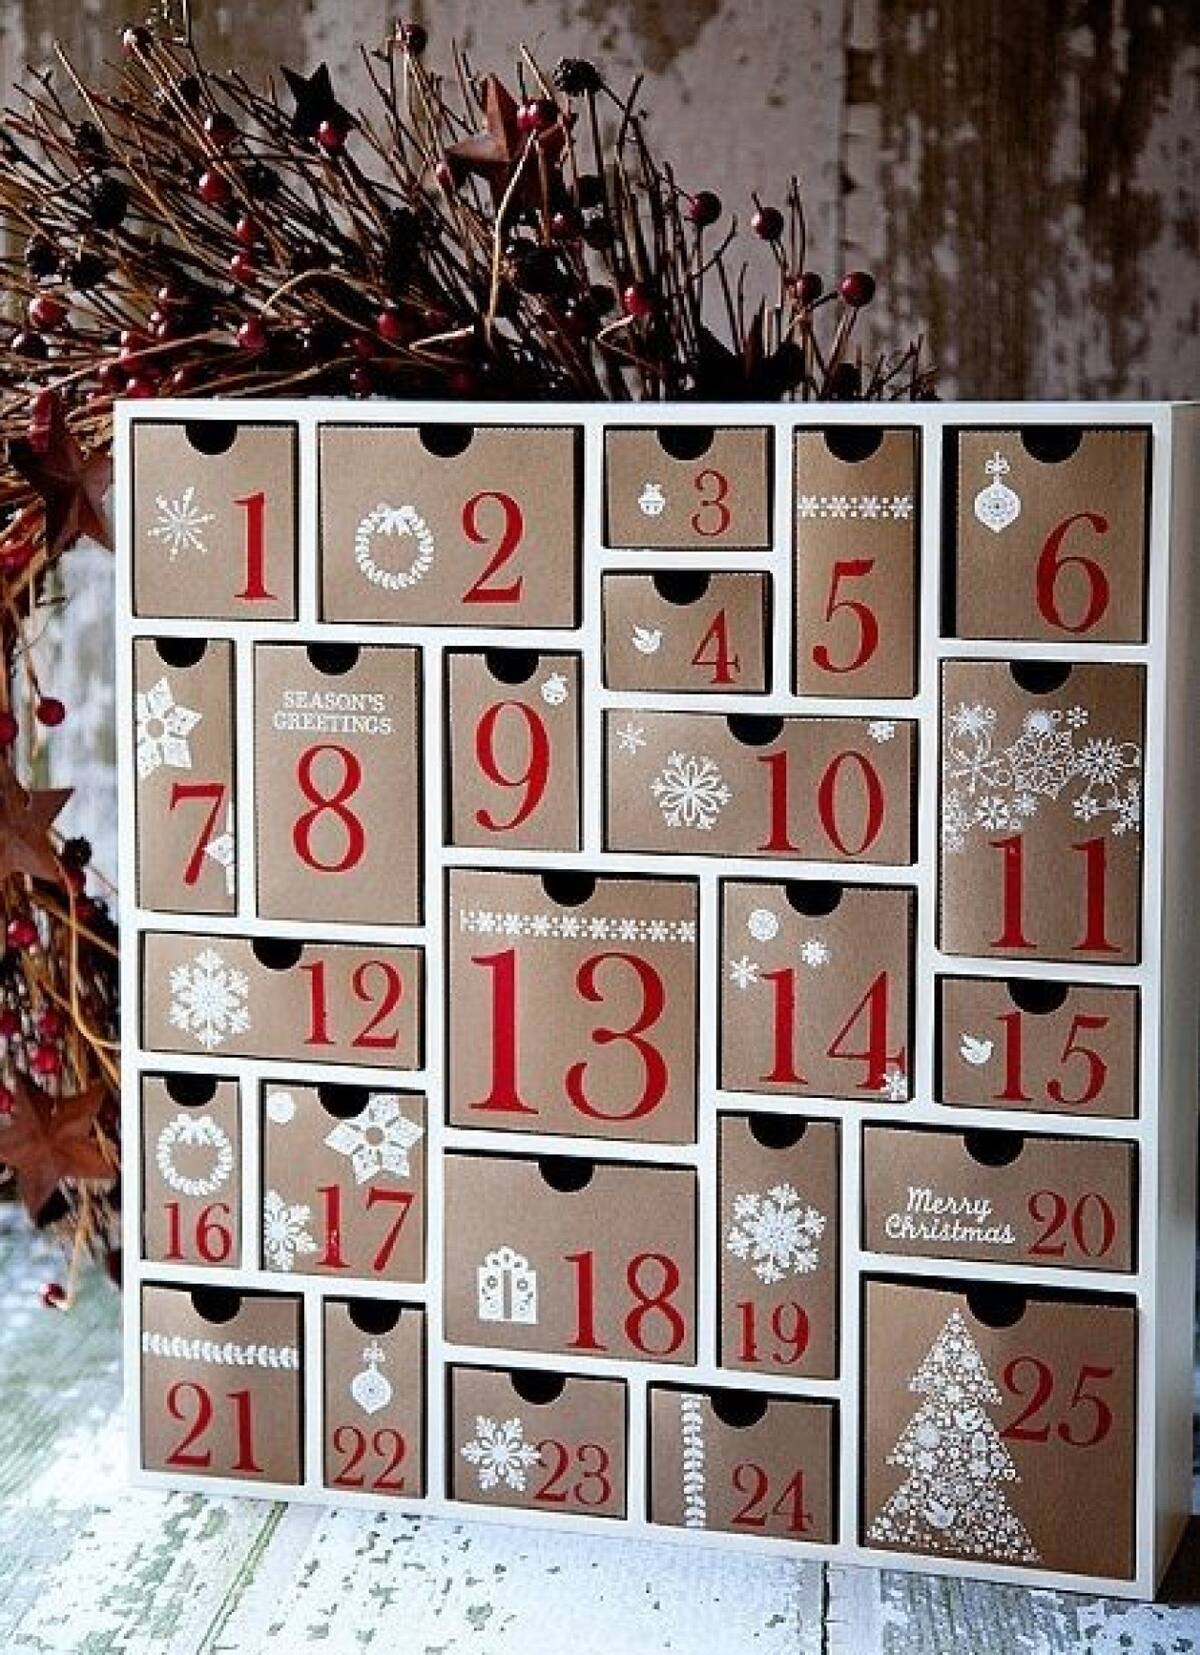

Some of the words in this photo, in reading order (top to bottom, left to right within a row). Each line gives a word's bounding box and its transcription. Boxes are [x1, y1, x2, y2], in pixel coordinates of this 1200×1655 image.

[234, 491, 277, 602] 1
[462, 491, 525, 604] 2
[691, 470, 732, 536] 3
[812, 558, 879, 673] 5
[1035, 512, 1111, 634] 6
[691, 608, 741, 684] 4
[273, 710, 392, 735] GREETINGS
[282, 690, 386, 713] SEASON'S
[292, 744, 367, 874] 8
[474, 701, 551, 832] 9
[756, 749, 886, 856] 10
[169, 782, 226, 887] 7
[988, 834, 1121, 953] 11
[299, 959, 404, 1050] 12
[470, 948, 670, 1122] 13
[759, 967, 906, 1091] 14
[994, 1010, 1109, 1105] 15
[163, 1202, 234, 1264] 16
[315, 1184, 416, 1273] 17
[885, 1212, 1016, 1244] Christmas
[906, 1186, 993, 1224] Merry
[1027, 1189, 1117, 1259] 20
[565, 1251, 689, 1357] 18
[735, 1300, 810, 1365] 19
[165, 1381, 265, 1475] 21
[1001, 1355, 1114, 1448] 25
[332, 1425, 406, 1490] 22
[534, 1438, 613, 1506] 23
[730, 1462, 815, 1533] 24
